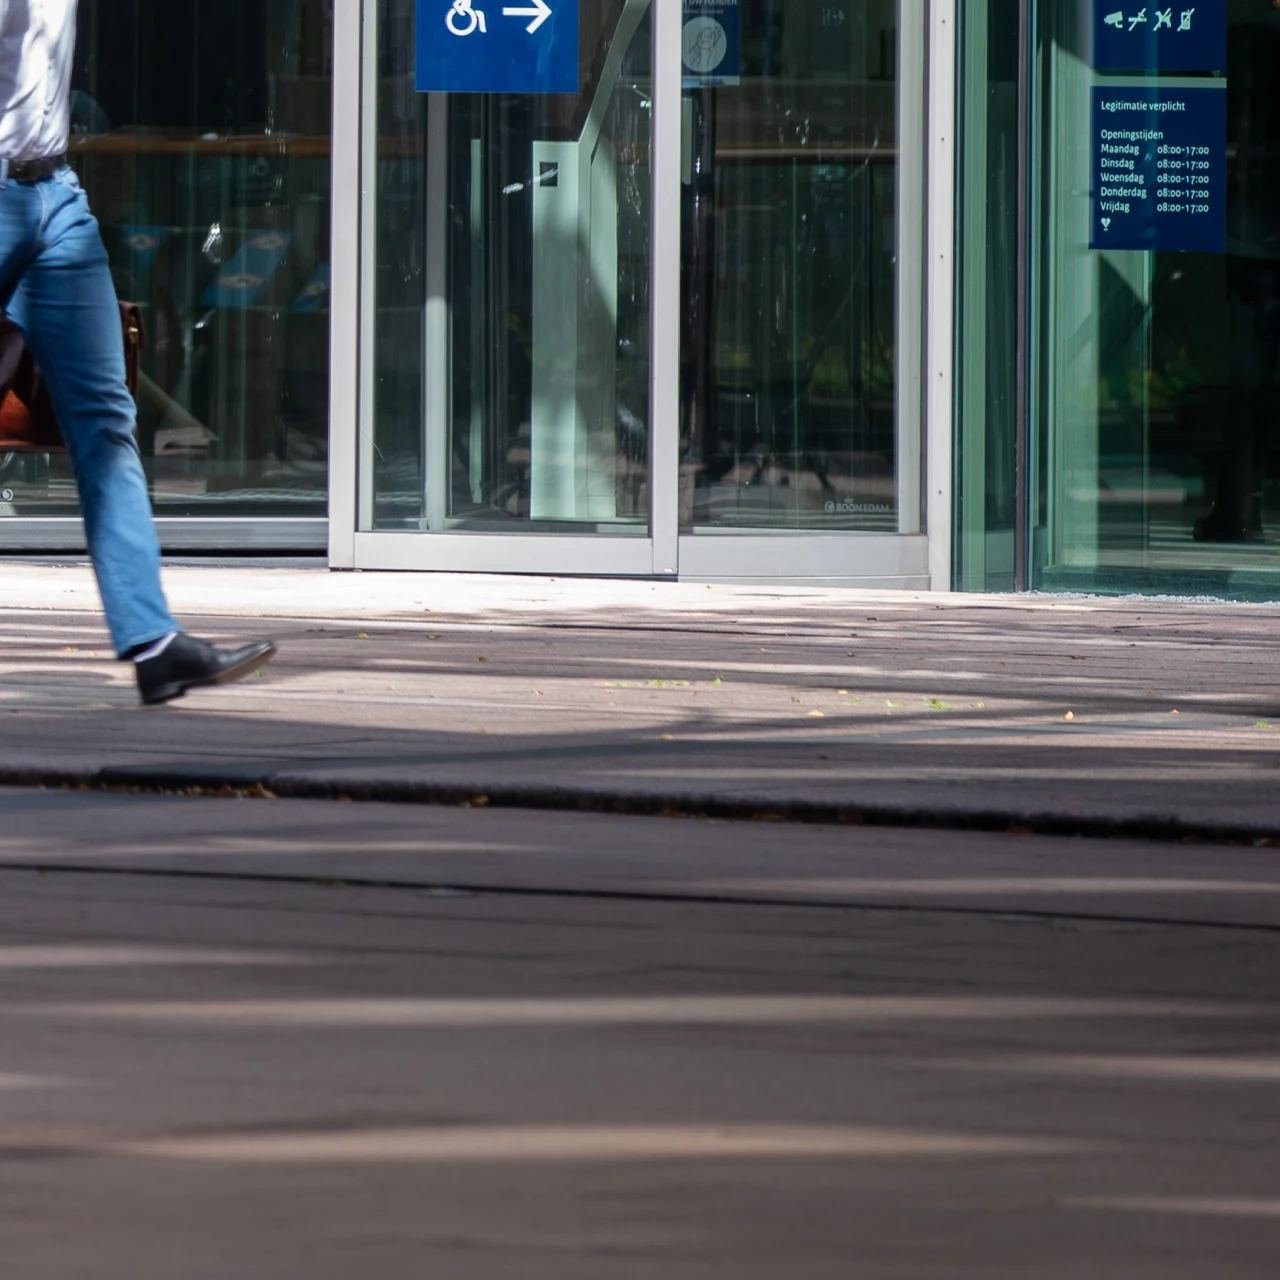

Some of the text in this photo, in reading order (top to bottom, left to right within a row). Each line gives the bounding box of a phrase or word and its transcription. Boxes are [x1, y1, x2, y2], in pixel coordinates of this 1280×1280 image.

[1101, 100, 1186, 113] Legitimatie verplicht
[1101, 129, 1164, 142] Openingstijden
[1101, 143, 1210, 156] Maandag 08:00-17:00
[1101, 158, 1210, 171] Dinsdag 08:00-17:00
[1100, 172, 1210, 185] Woensdag 08:00-17:00
[1100, 187, 1210, 199] Donderdag 08:00-17:00
[1100, 201, 1210, 214] Vrijdag 08:00-17:00
[836, 503, 890, 513] BOON EDAM
